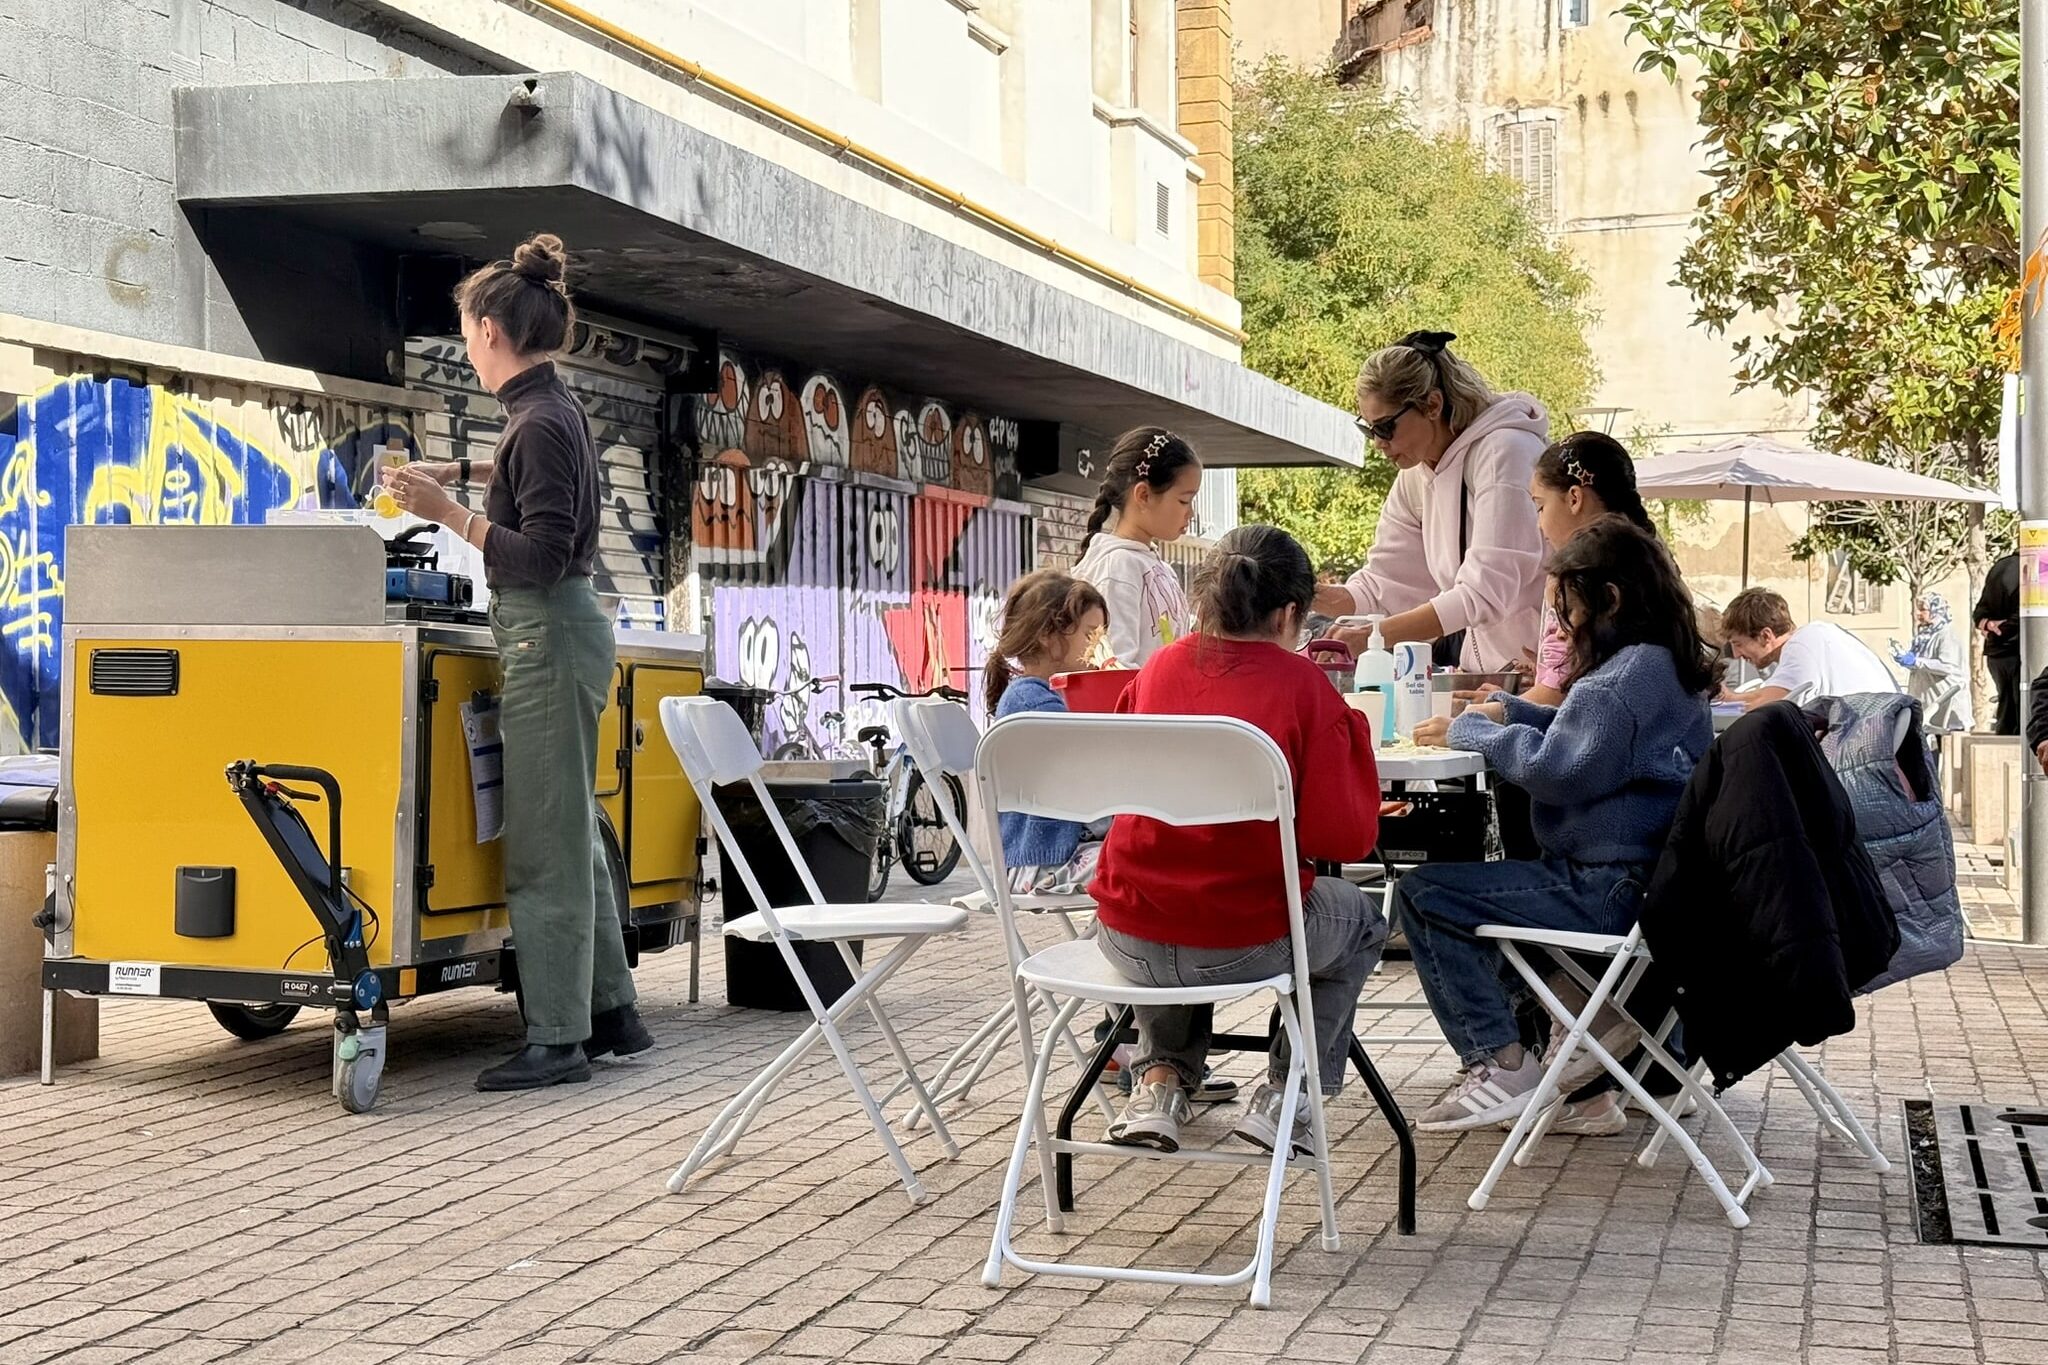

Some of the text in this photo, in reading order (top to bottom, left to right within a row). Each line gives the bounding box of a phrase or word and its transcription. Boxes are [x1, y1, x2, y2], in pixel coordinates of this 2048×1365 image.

[115, 966, 152, 977] RUNNER
[441, 961, 477, 982] RUNNER
[284, 982, 308, 990] R 0457
